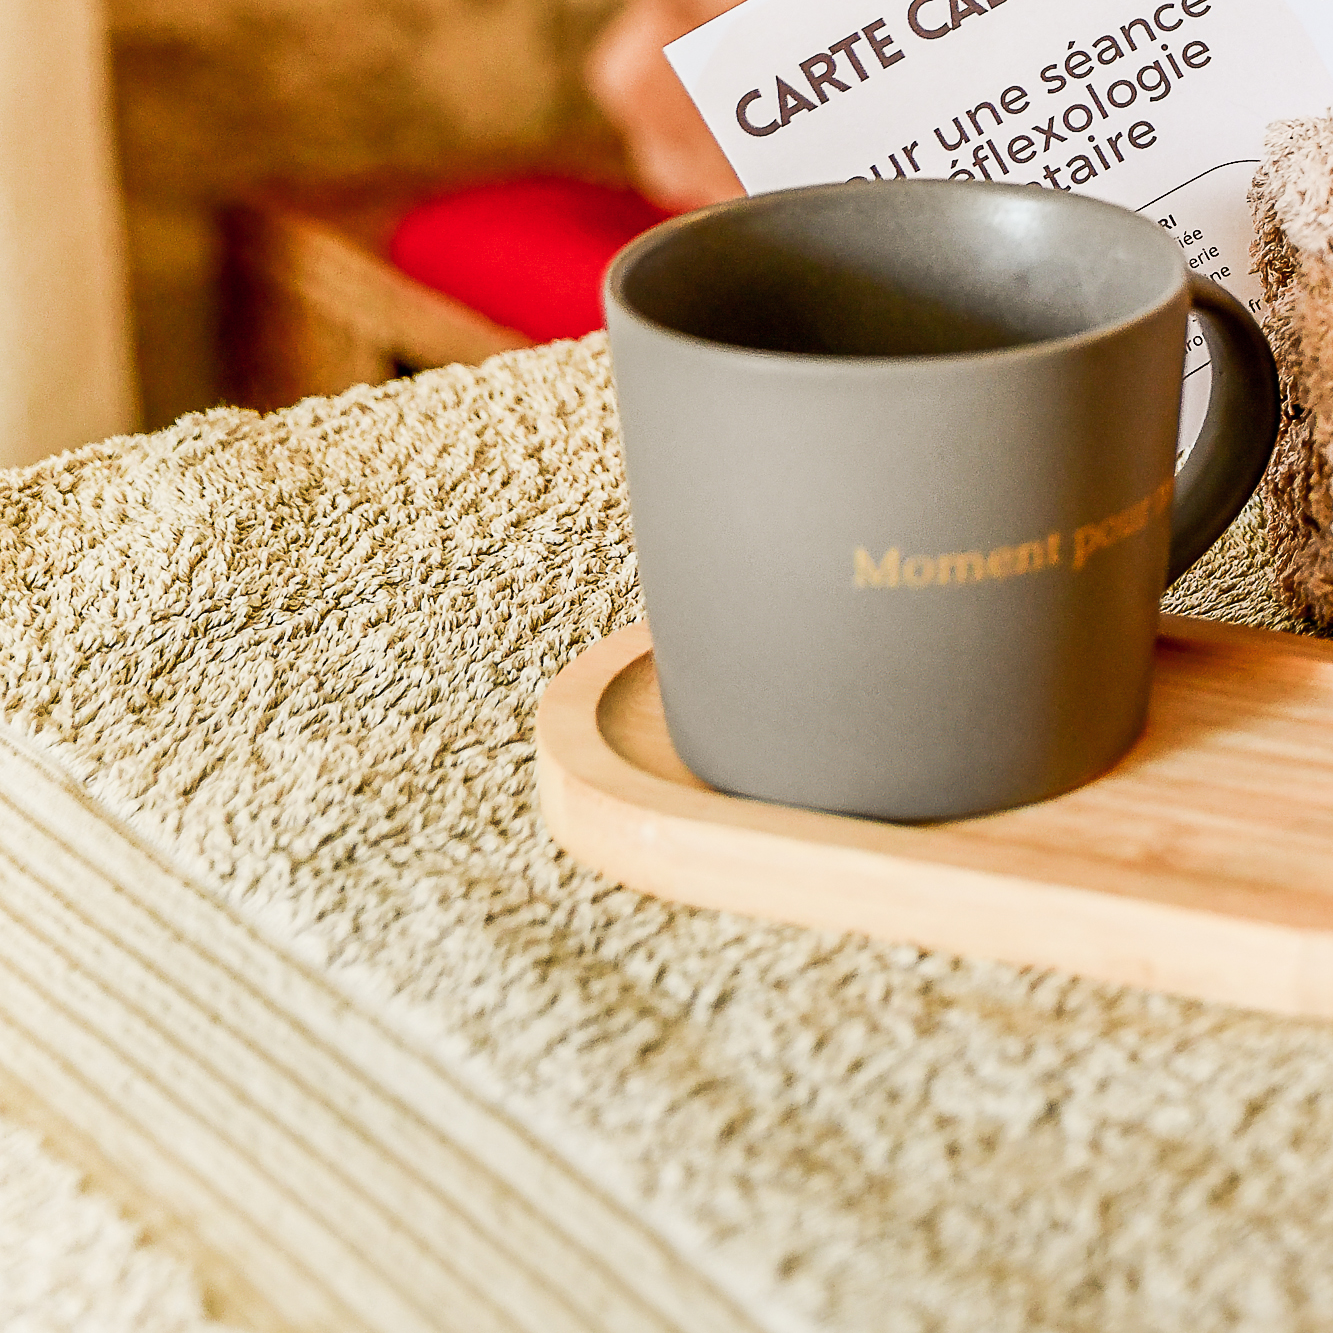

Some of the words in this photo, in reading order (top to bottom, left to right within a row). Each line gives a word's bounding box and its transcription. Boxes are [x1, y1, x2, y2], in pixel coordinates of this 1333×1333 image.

[736, 18, 905, 137] CARTE
[933, 85, 1030, 152] une
[854, 532, 1061, 588] Moment
